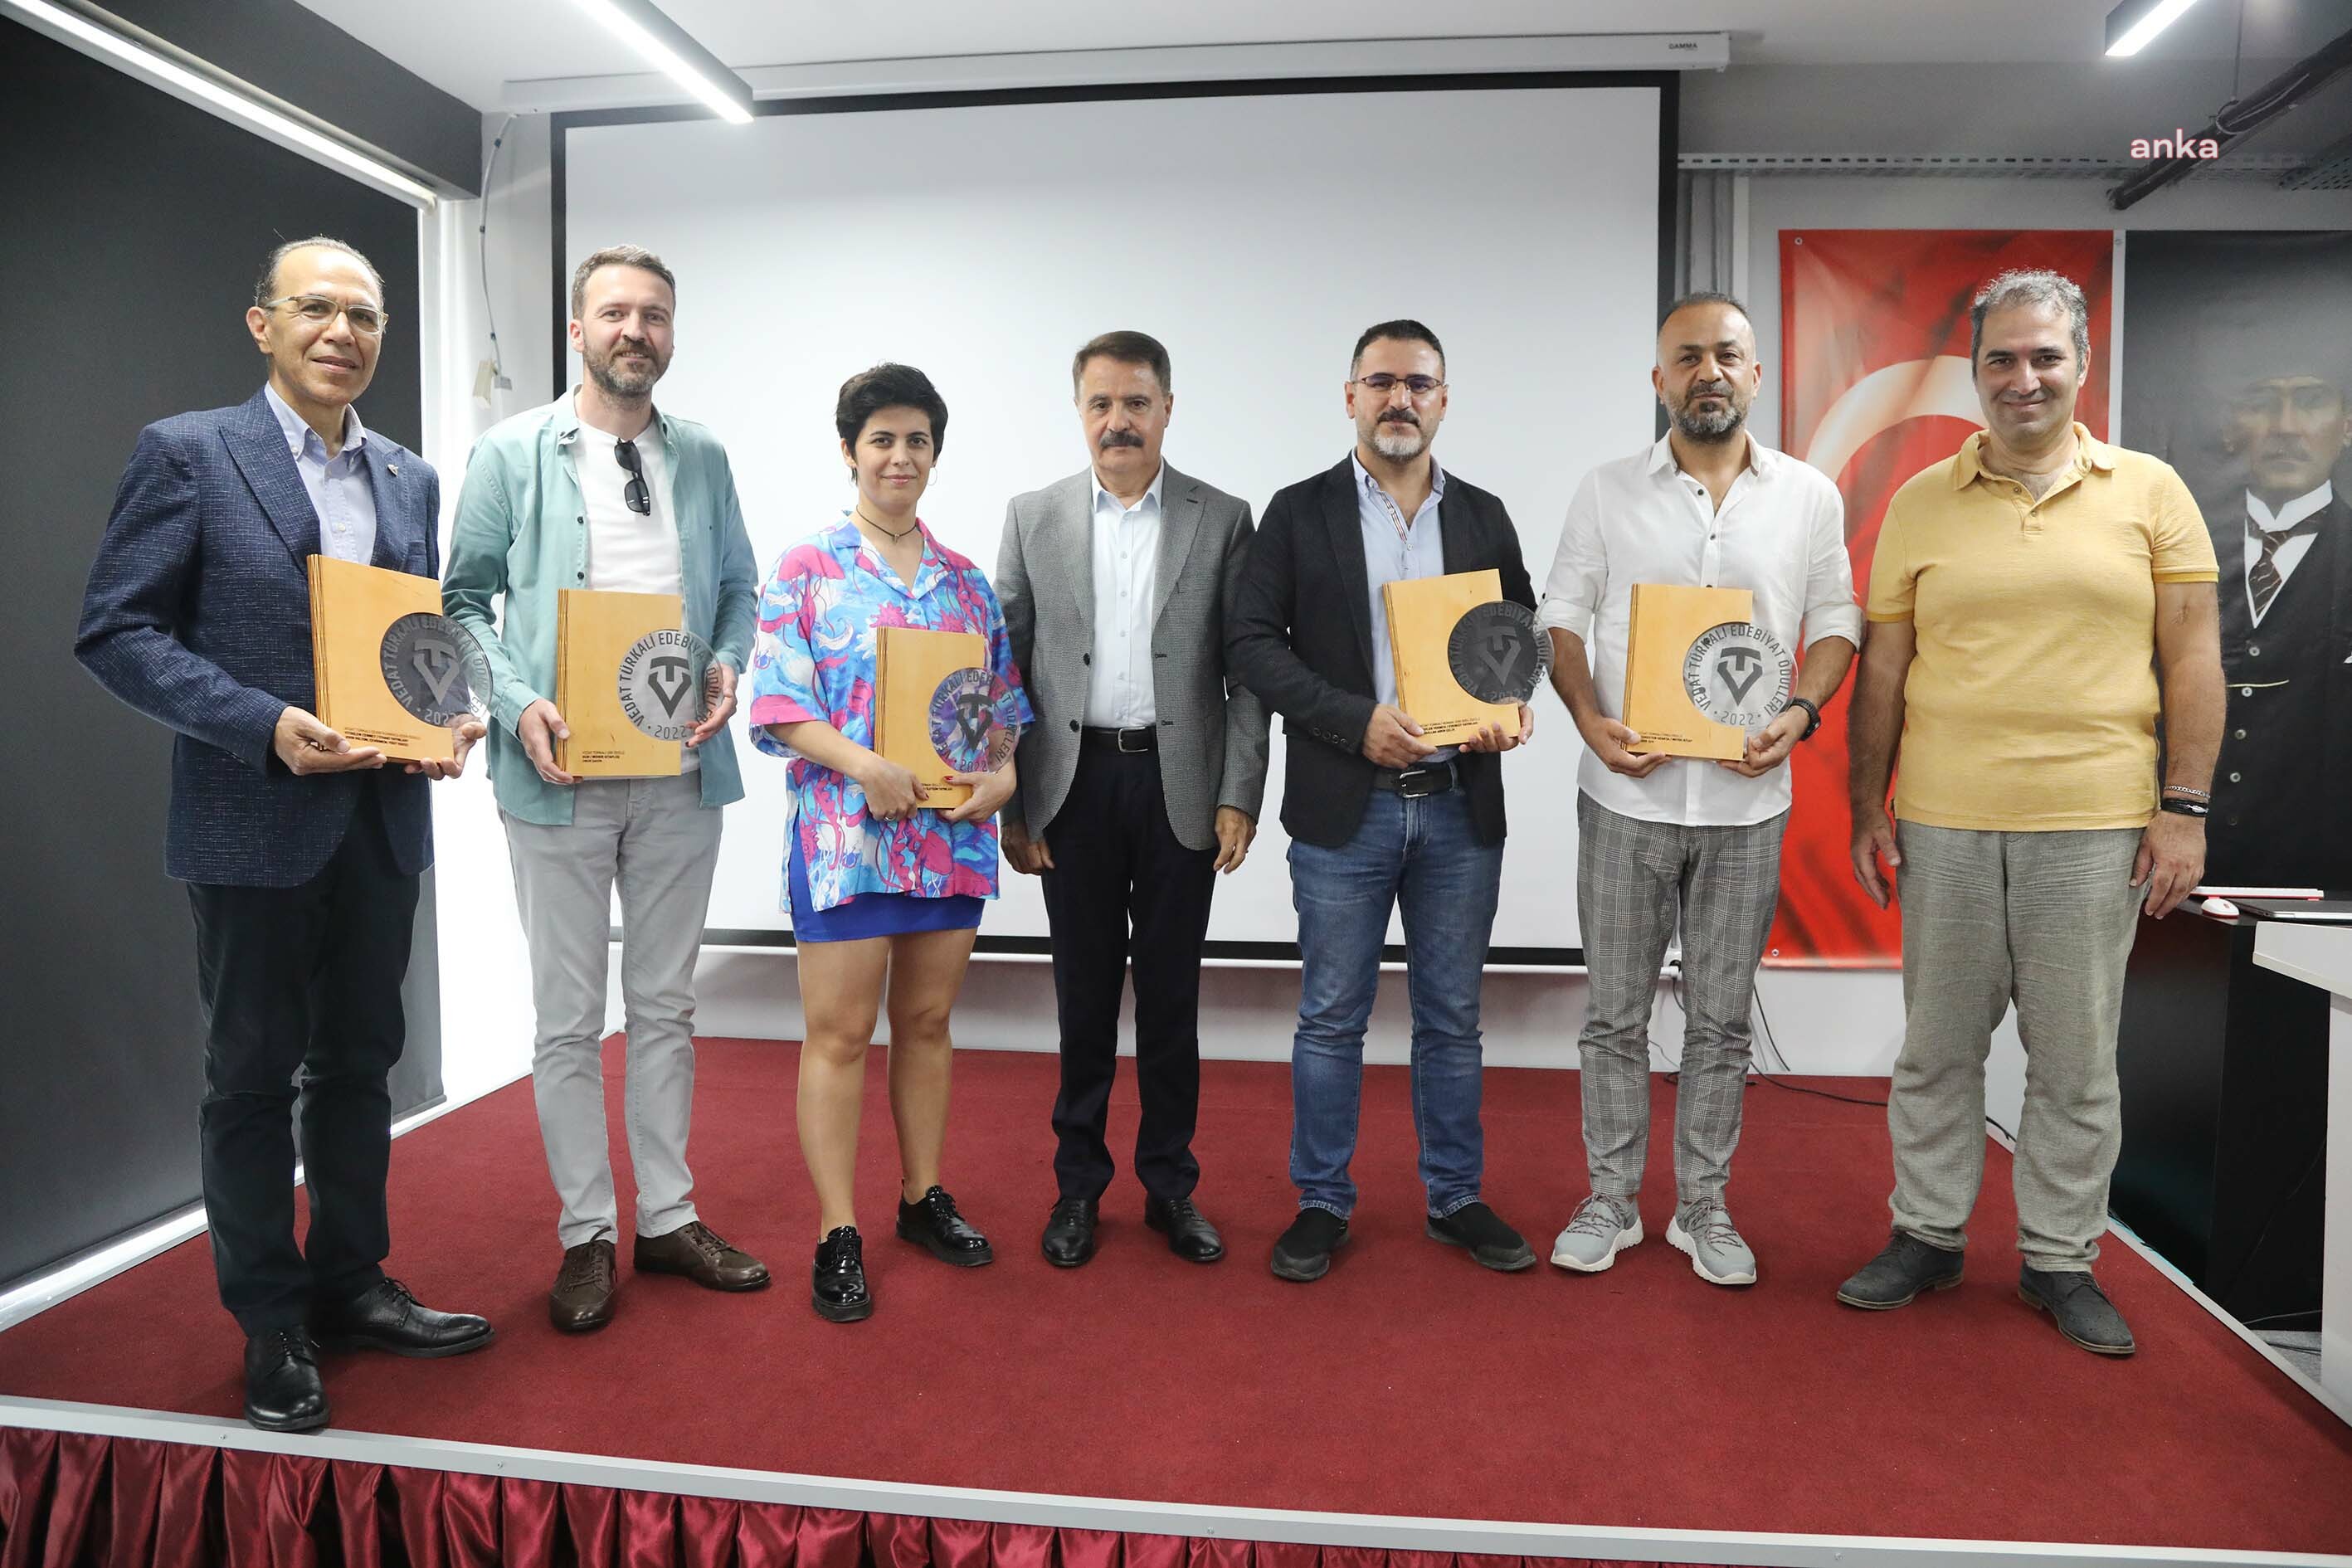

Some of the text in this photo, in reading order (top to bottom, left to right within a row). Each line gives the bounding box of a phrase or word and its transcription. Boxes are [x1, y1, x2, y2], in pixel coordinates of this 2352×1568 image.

[384, 664, 413, 708] VEDAT
[1688, 673, 1712, 711] VEDAT
[620, 686, 645, 727] VEDAT
[1721, 711, 1755, 726] 2022
[654, 725, 688, 740] 2022
